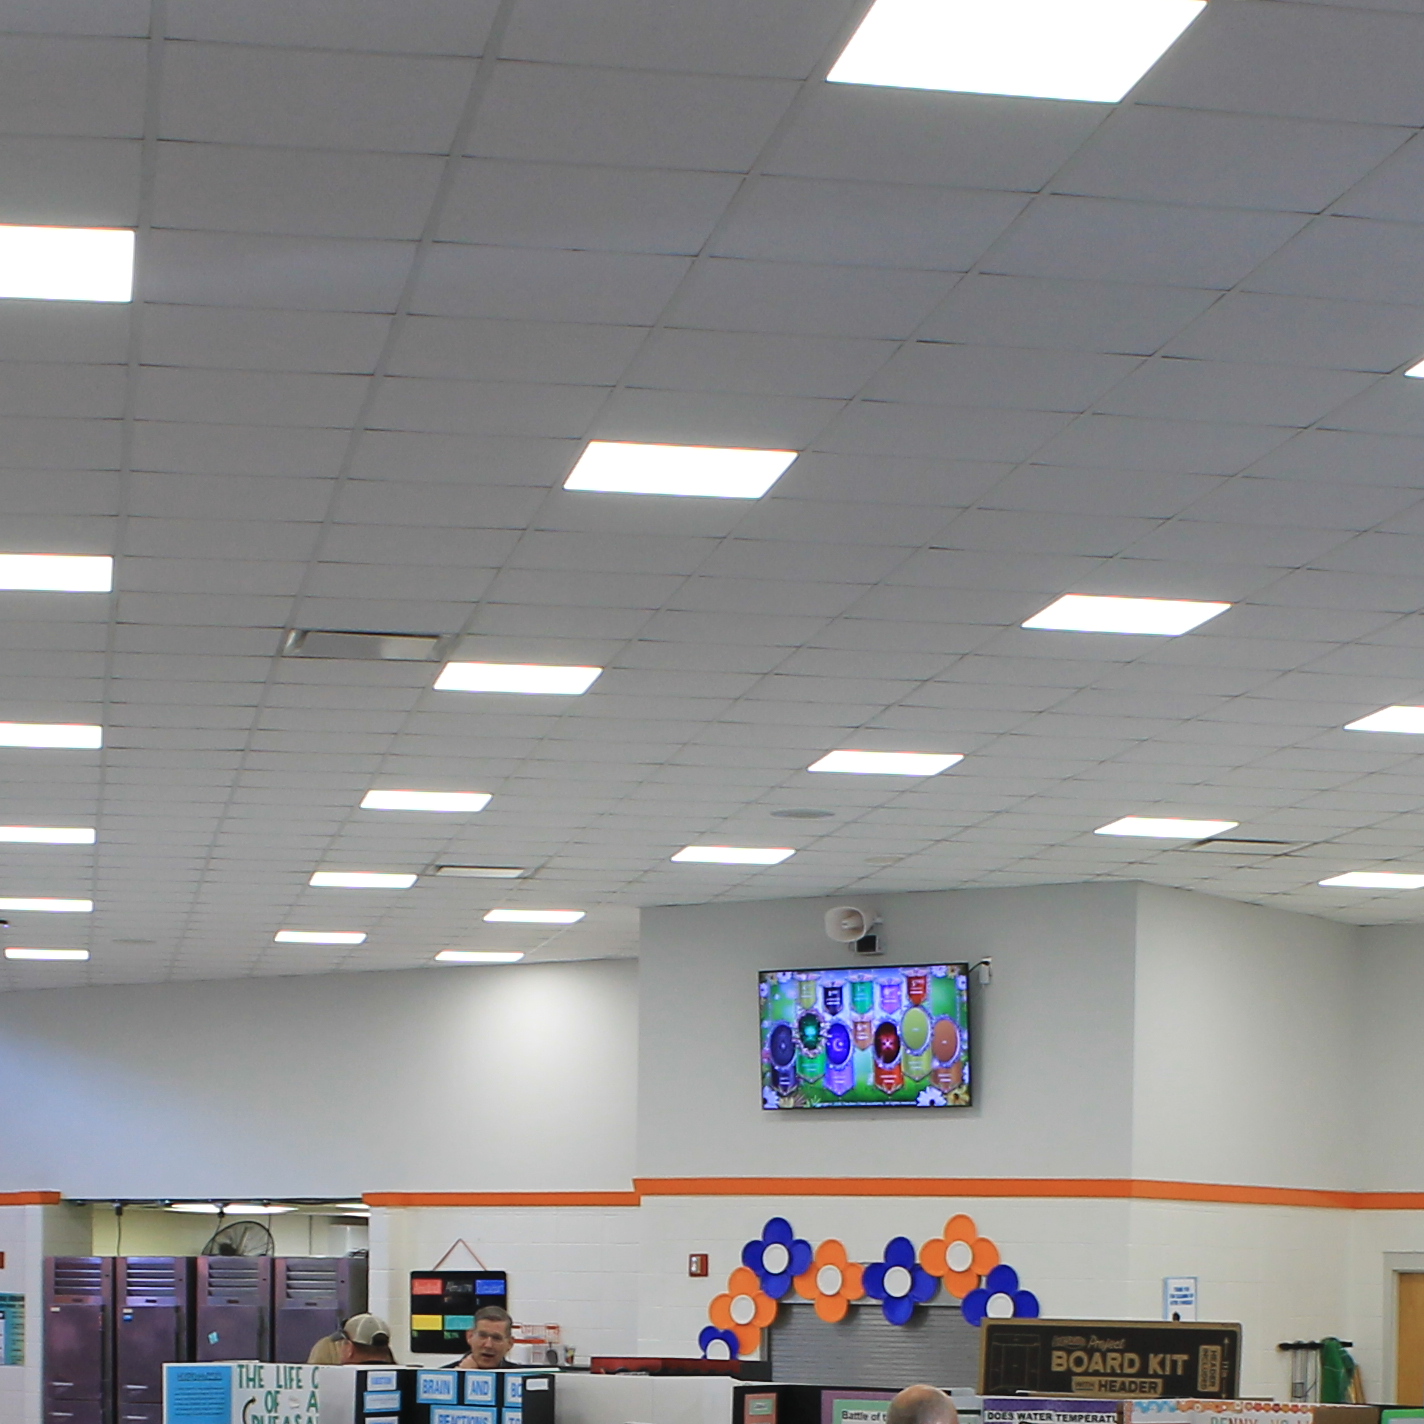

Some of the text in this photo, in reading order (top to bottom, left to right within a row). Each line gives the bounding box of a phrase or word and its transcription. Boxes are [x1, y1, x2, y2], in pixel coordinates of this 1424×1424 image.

[1051, 1350, 1189, 1376] BOARD KIT
[237, 1365, 303, 1389] THE LIFE
[422, 1379, 490, 1396] BRAIN AND
[1098, 1379, 1159, 1395] HEADER
[264, 1391, 281, 1414] OF
[841, 1410, 869, 1422] Battle
[988, 1411, 1014, 1422] DOES
[1017, 1412, 1053, 1422] WATER
